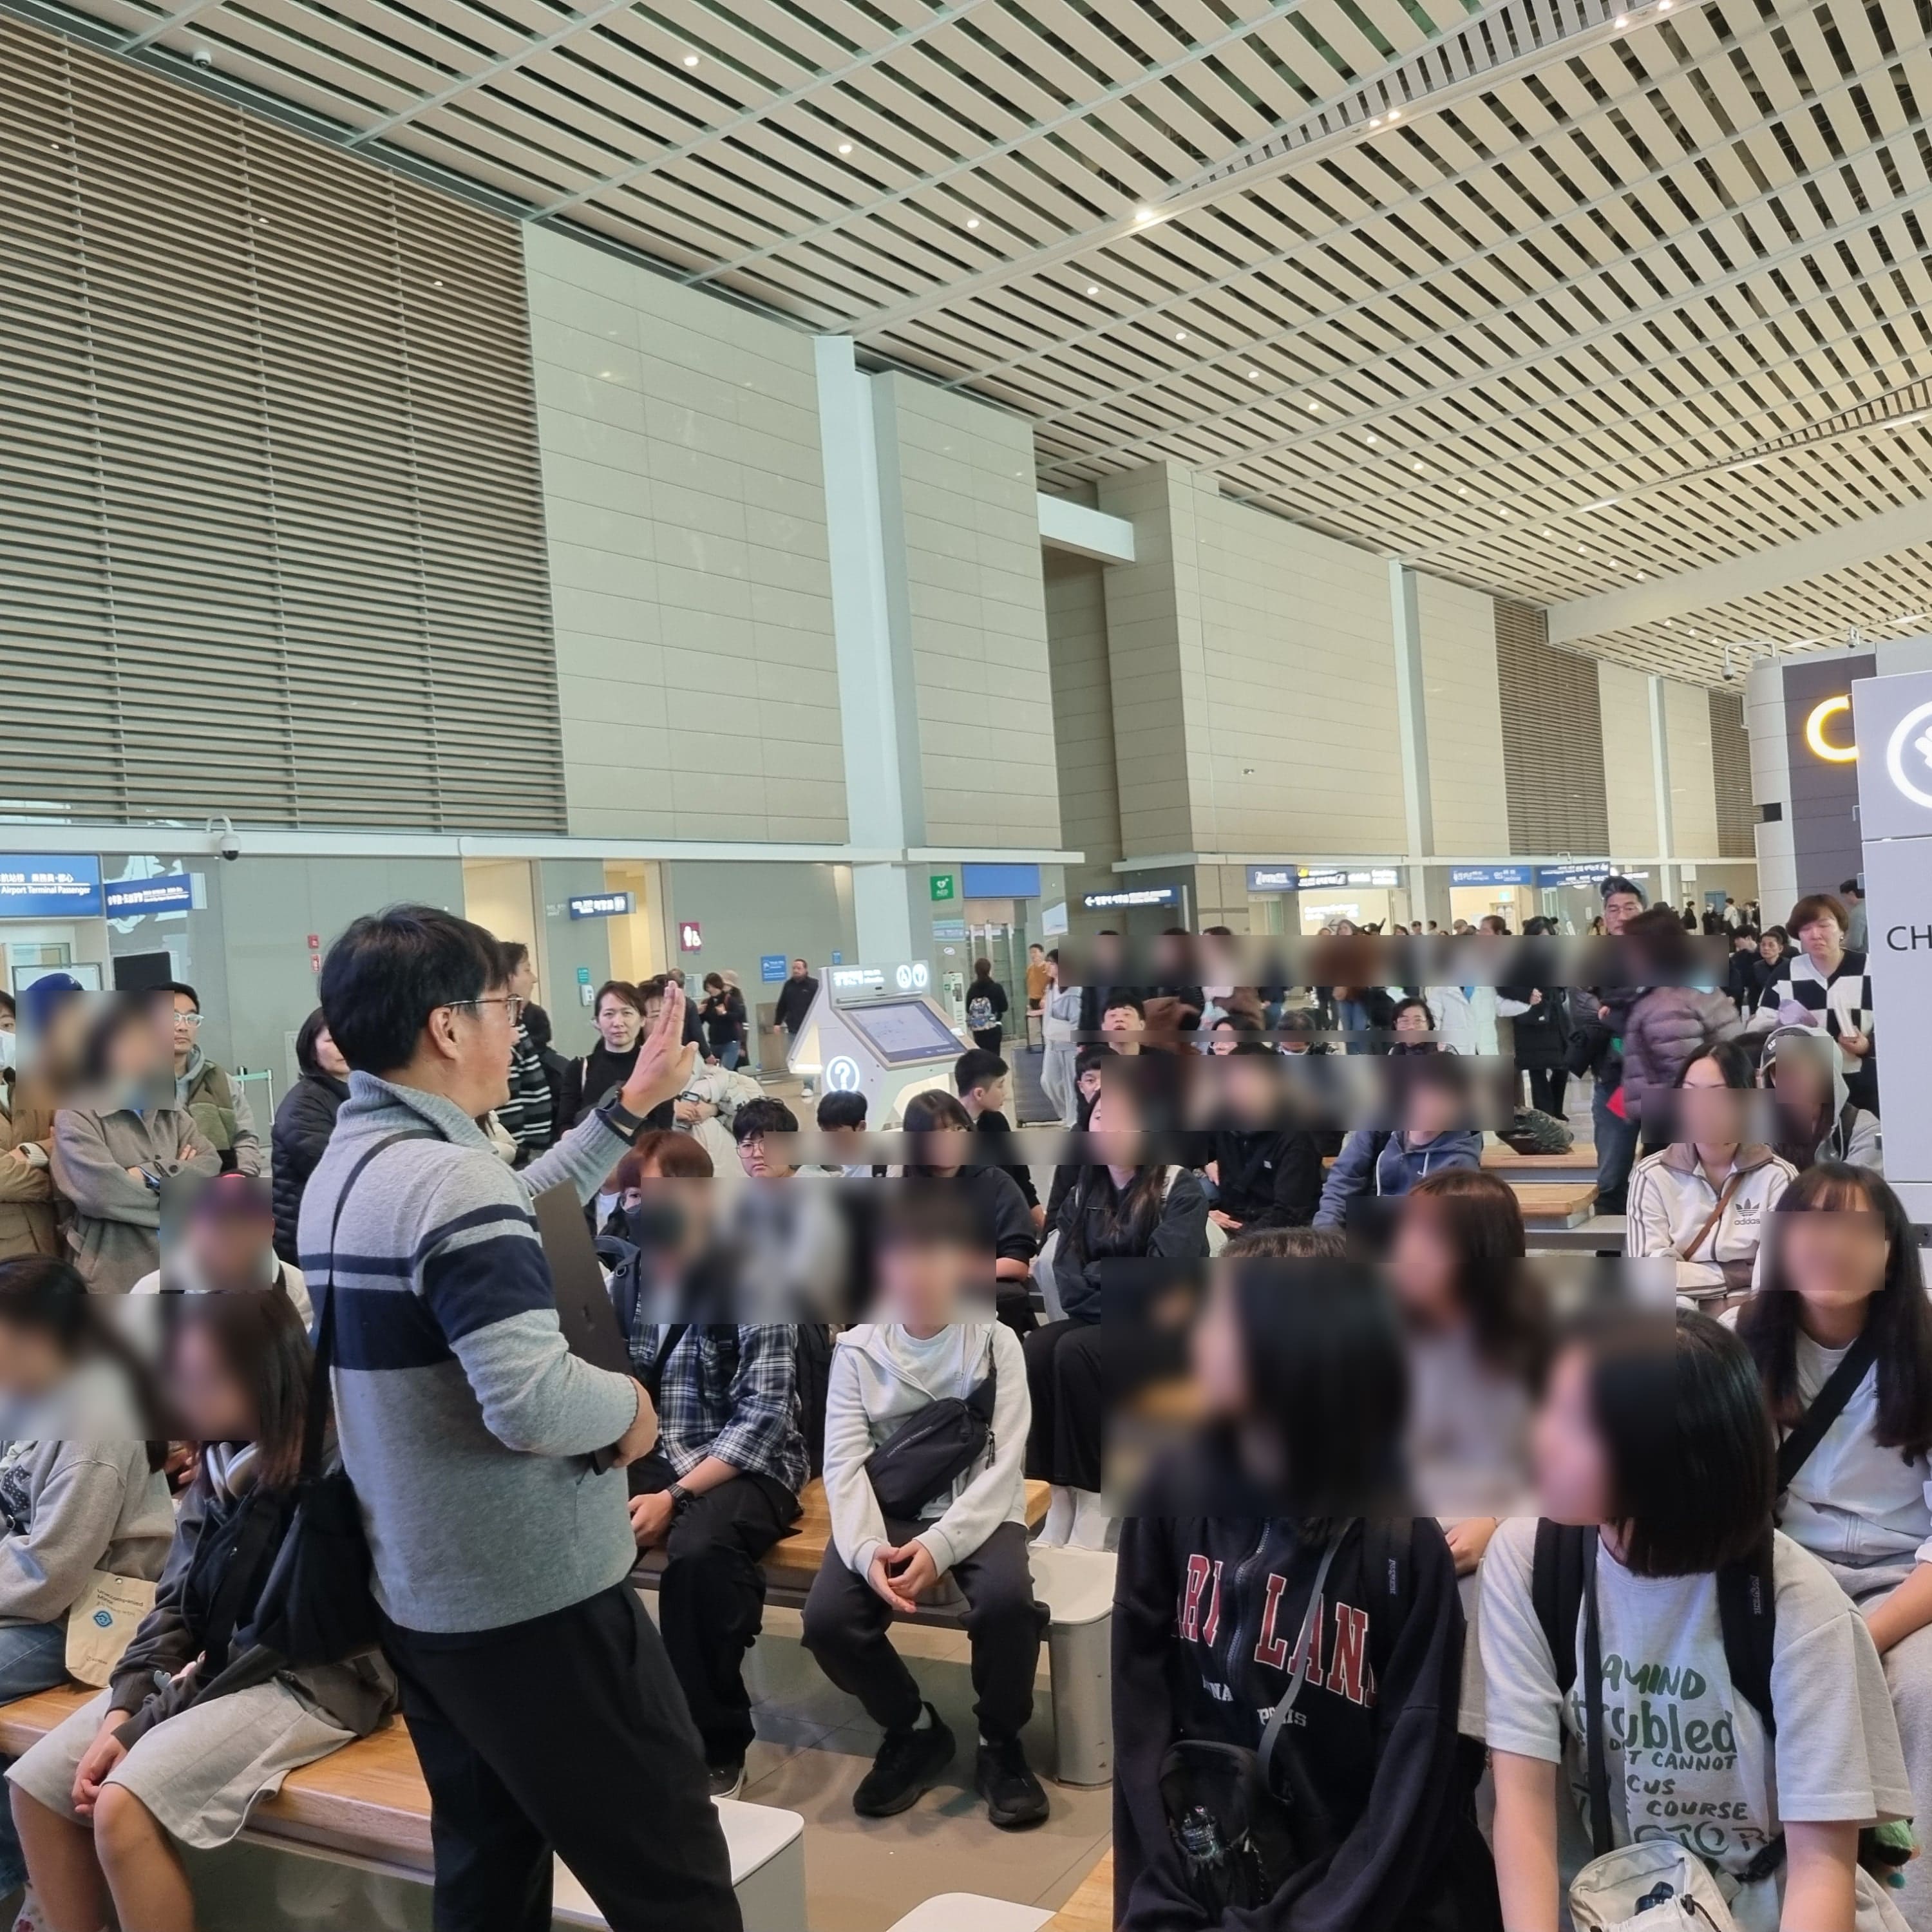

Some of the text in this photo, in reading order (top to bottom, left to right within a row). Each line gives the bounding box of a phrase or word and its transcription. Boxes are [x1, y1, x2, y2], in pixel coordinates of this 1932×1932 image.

[1, 886, 91, 896] Airport Terminal Passenger
[1651, 1750, 1738, 1771] CANNOT
[1626, 1774, 1676, 1795] CUS
[1645, 1800, 1748, 1821] COURSE
